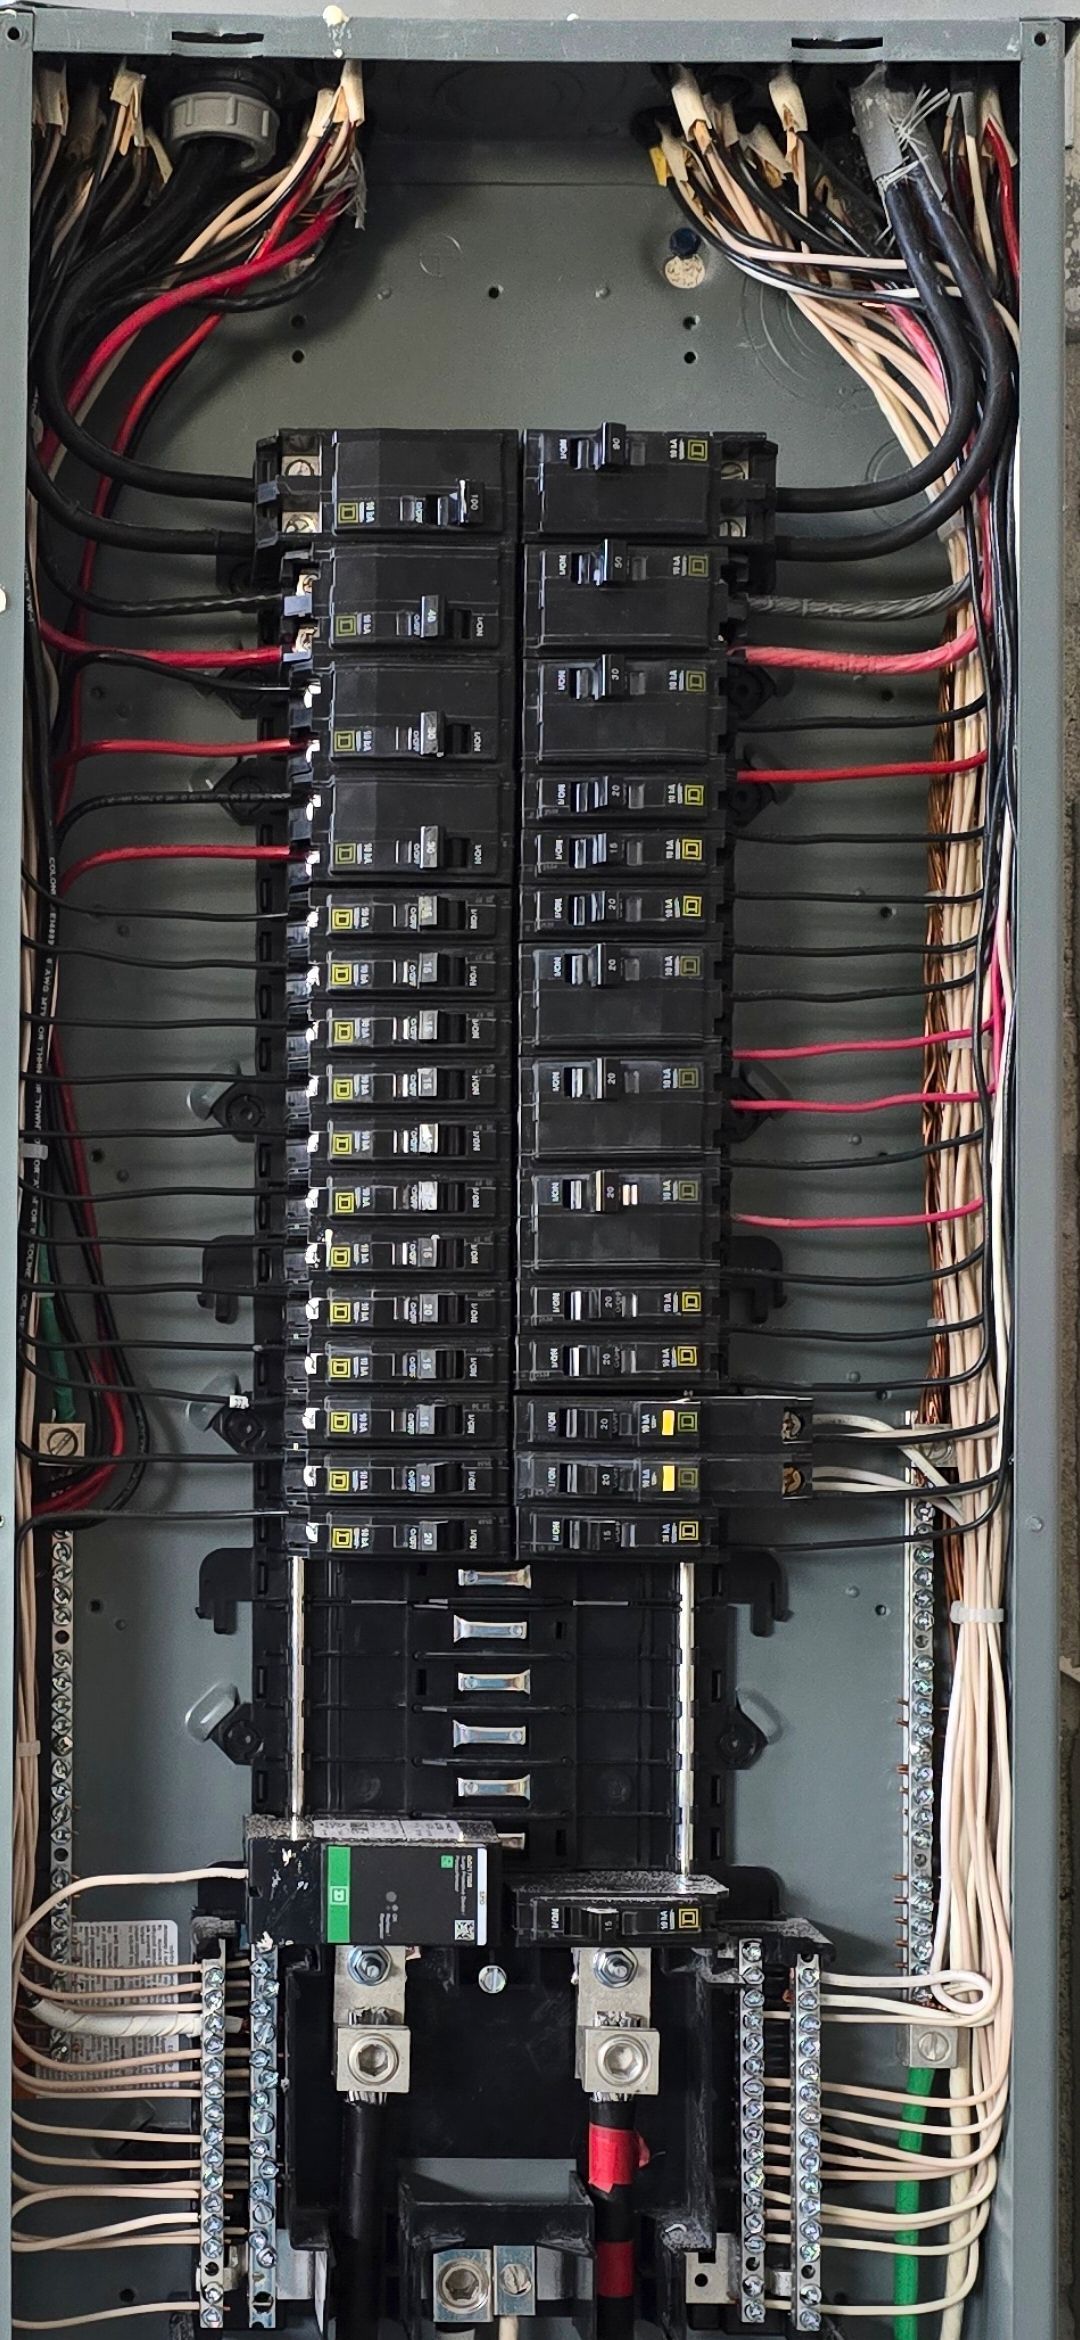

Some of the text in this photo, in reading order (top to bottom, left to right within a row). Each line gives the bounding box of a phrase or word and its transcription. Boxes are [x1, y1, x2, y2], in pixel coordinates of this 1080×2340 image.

[470, 494, 479, 511] 100
[614, 556, 622, 569] 50
[427, 609, 437, 623] 40
[611, 668, 619, 680] 30
[612, 785, 620, 797] 20
[610, 843, 617, 853] 15
[608, 898, 616, 910] 20
[423, 962, 432, 973] 15
[608, 959, 616, 971] 20
[42, 969, 51, 992] AWG
[38, 1026, 44, 1040] OR
[424, 1077, 432, 1089] 15
[607, 1072, 616, 1085] 20
[606, 1186, 614, 1199] 20
[424, 1247, 432, 1258] 15
[605, 1296, 613, 1308] 20
[424, 1303, 432, 1315] 20
[423, 1358, 431, 1369] 15
[603, 1353, 610, 1365] 20
[420, 1416, 429, 1427] 15
[601, 1418, 608, 1430] 20
[421, 1475, 430, 1487] 20
[602, 1474, 610, 1486] 20
[424, 1532, 432, 1545] 20
[603, 1530, 611, 1541] 15
[605, 1921, 612, 1931] 15
